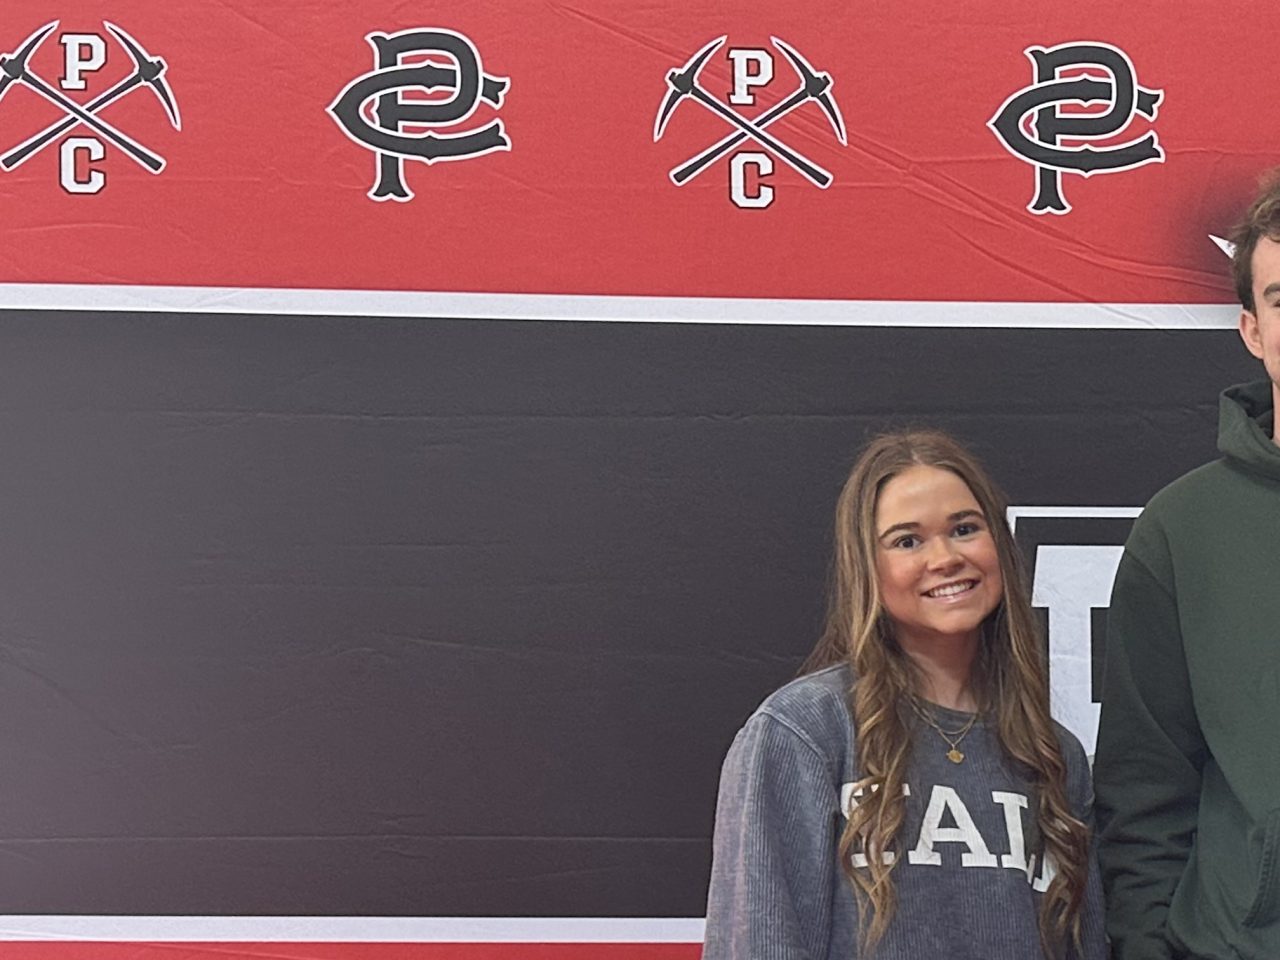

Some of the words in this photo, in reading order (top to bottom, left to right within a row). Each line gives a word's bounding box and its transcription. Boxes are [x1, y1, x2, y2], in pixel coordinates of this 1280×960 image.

[59, 32, 106, 91] P
[725, 47, 775, 106] P
[59, 136, 107, 195] C
[727, 150, 775, 209] C
